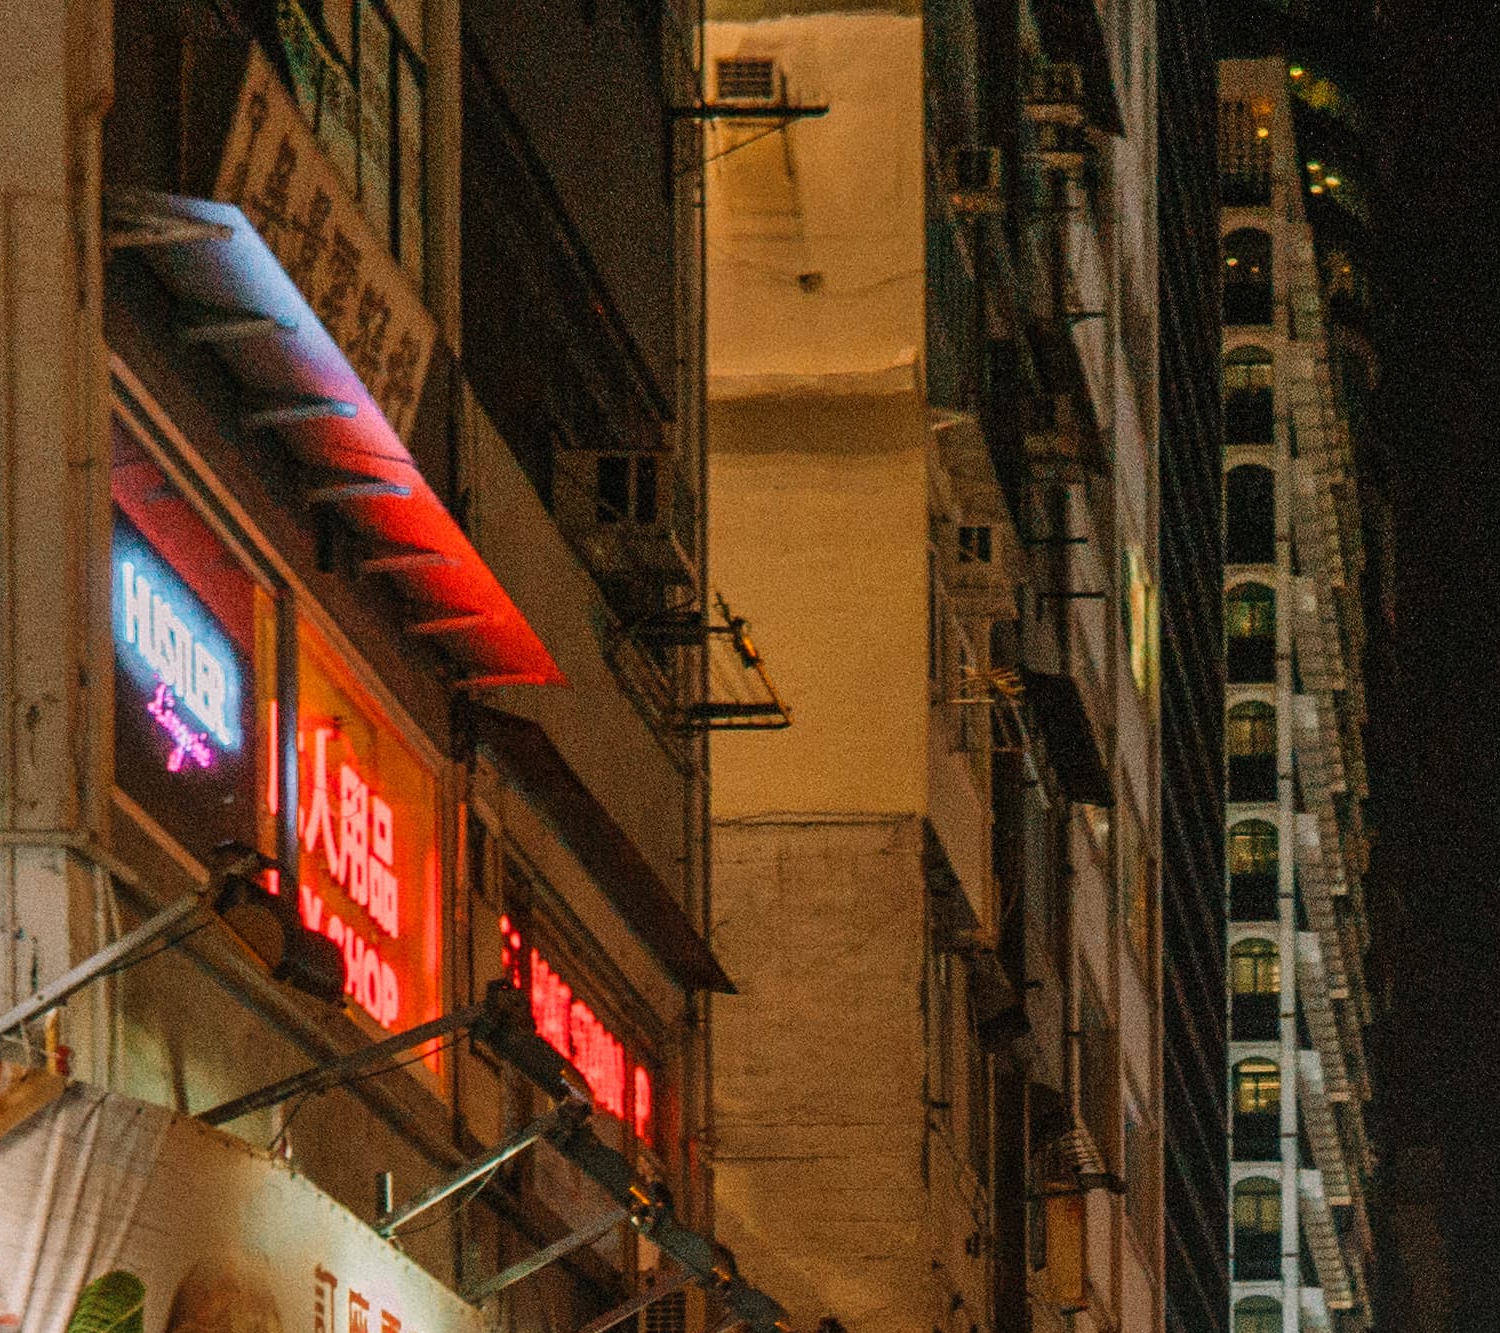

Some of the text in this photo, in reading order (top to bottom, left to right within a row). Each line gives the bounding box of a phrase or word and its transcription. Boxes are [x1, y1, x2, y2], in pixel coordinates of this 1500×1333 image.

[122, 560, 233, 749] HUSTLER
[299, 725, 399, 939] 人用品
